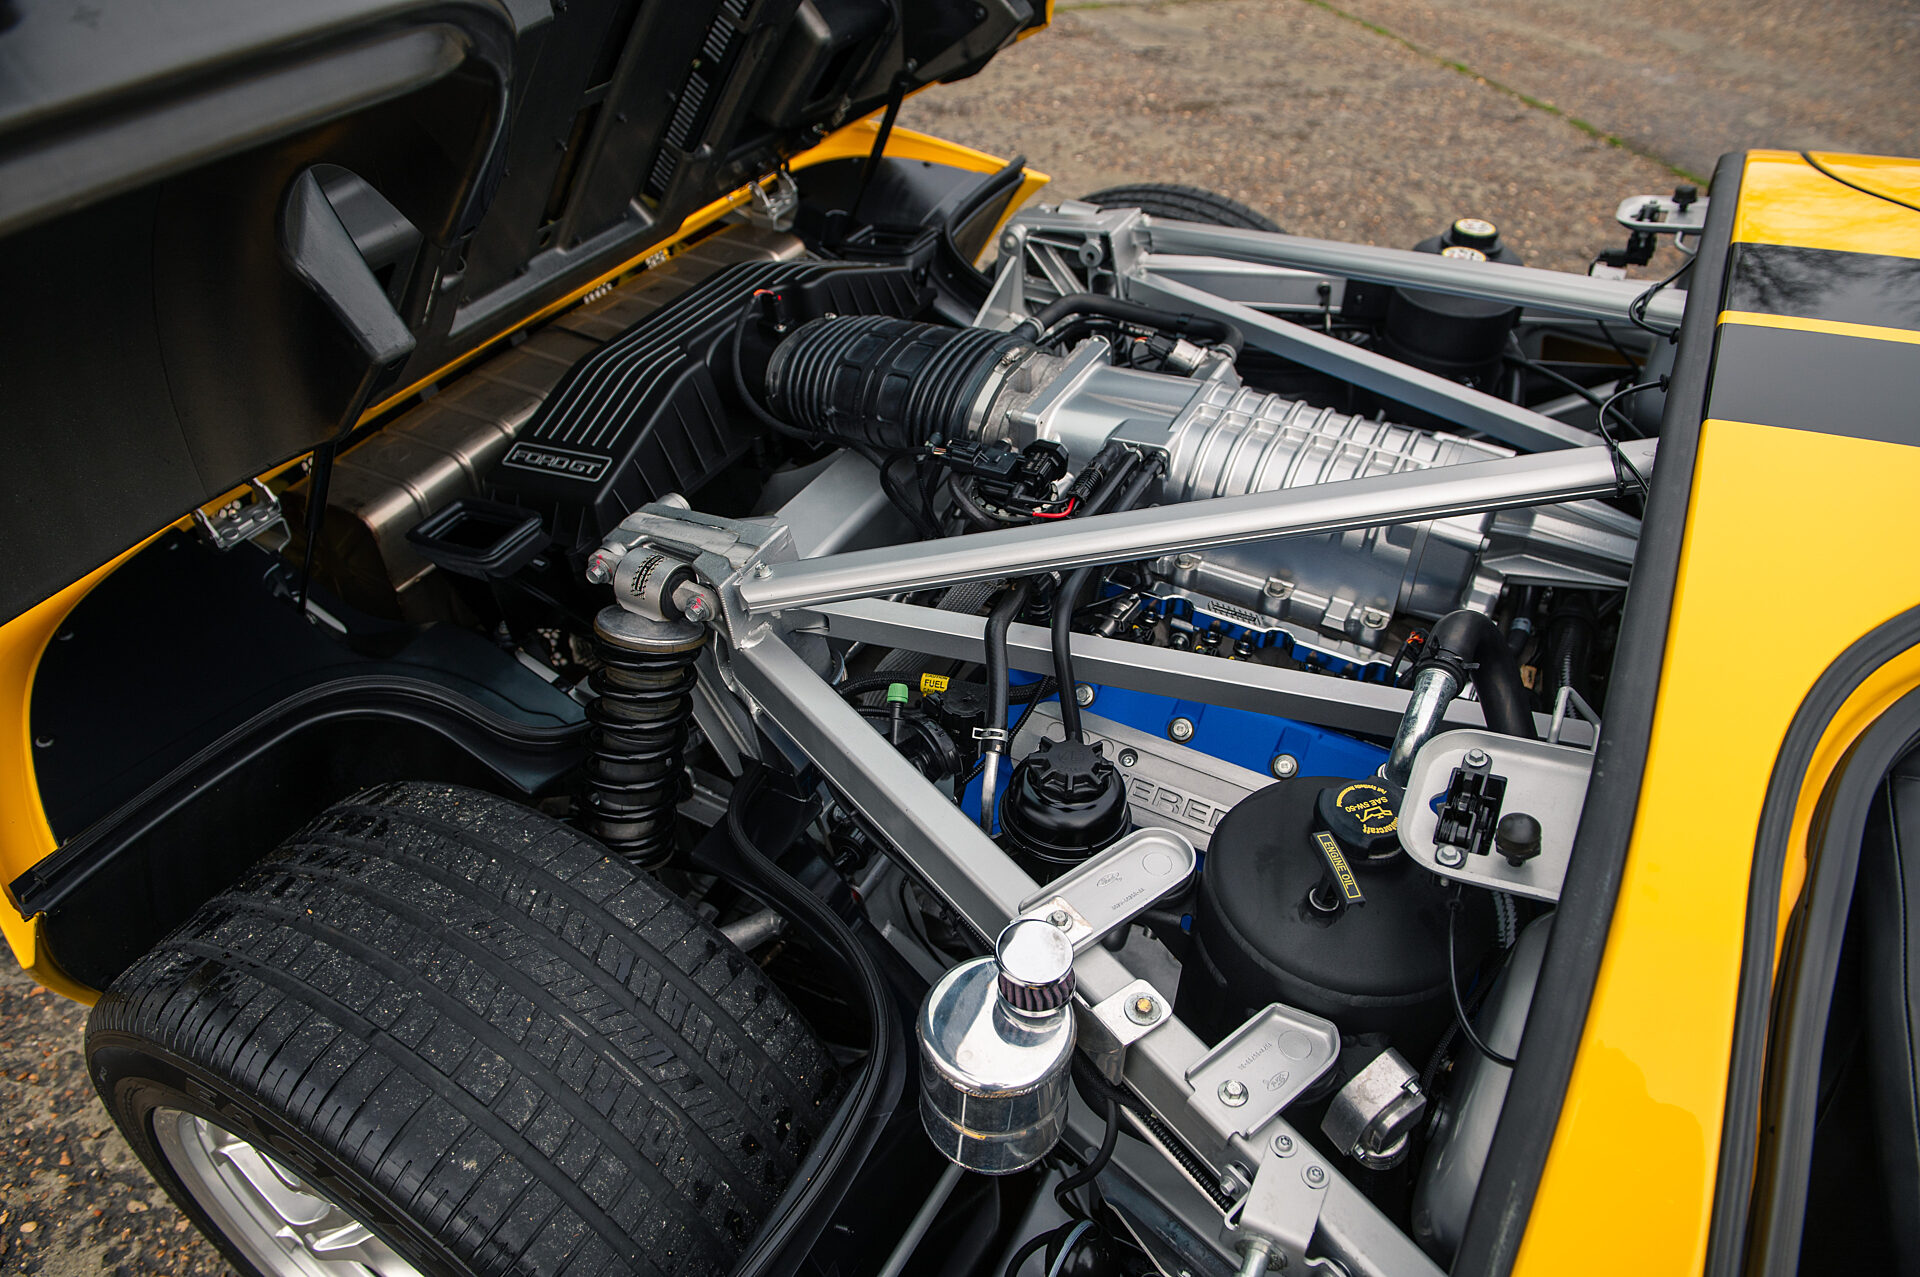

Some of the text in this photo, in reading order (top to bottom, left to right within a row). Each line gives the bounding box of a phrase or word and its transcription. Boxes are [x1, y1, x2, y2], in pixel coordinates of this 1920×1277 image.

[511, 449, 602, 474] FORD GT
[924, 679, 945, 689] FUEL
[1345, 801, 1371, 813] 5W-50
[1368, 796, 1389, 807] SAE
[1362, 816, 1398, 835] otorcraft
[1323, 841, 1354, 890] ENGINE OIL
